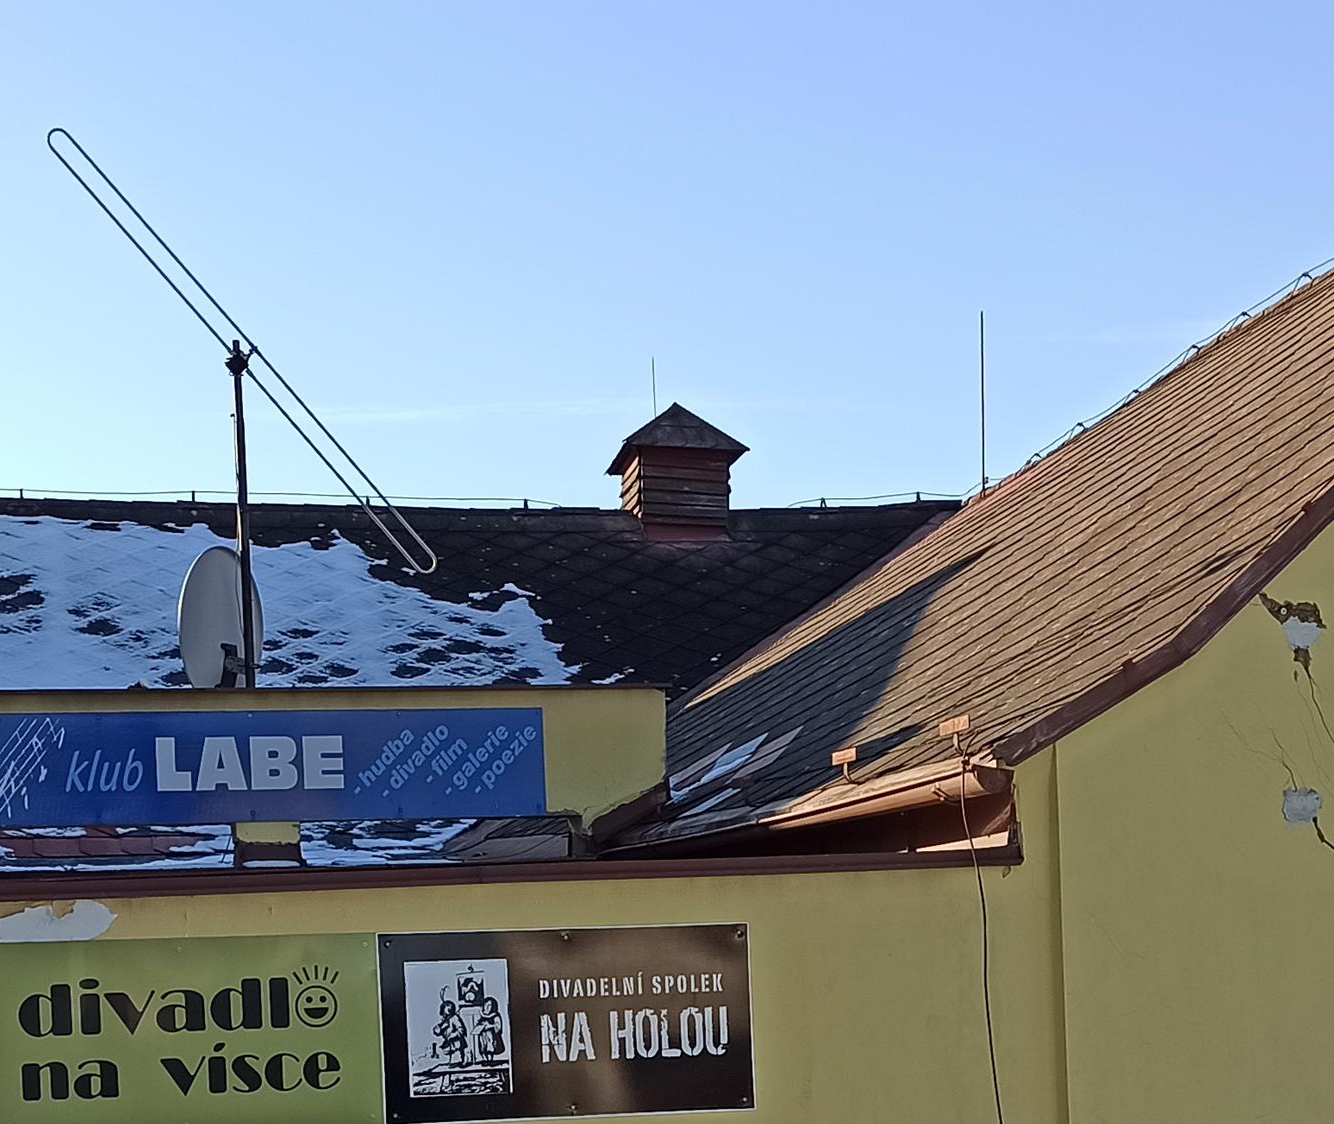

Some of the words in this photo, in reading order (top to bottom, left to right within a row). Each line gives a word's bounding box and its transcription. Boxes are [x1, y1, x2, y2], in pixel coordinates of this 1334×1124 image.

[67, 750, 143, 792] klub
[155, 735, 345, 790] LABE
[359, 729, 414, 787] hudba
[390, 725, 449, 789] divadlo
[431, 738, 467, 776] film
[452, 725, 509, 790] galerie
[481, 726, 536, 790] poezie
[539, 971, 643, 999] DIVADELNÍ
[652, 972, 724, 993] SPOLEK
[539, 1012, 595, 1063] NA
[609, 1006, 729, 1060] HOLOU
[21, 1060, 119, 1101] na
[160, 1042, 342, 1096] vísce
